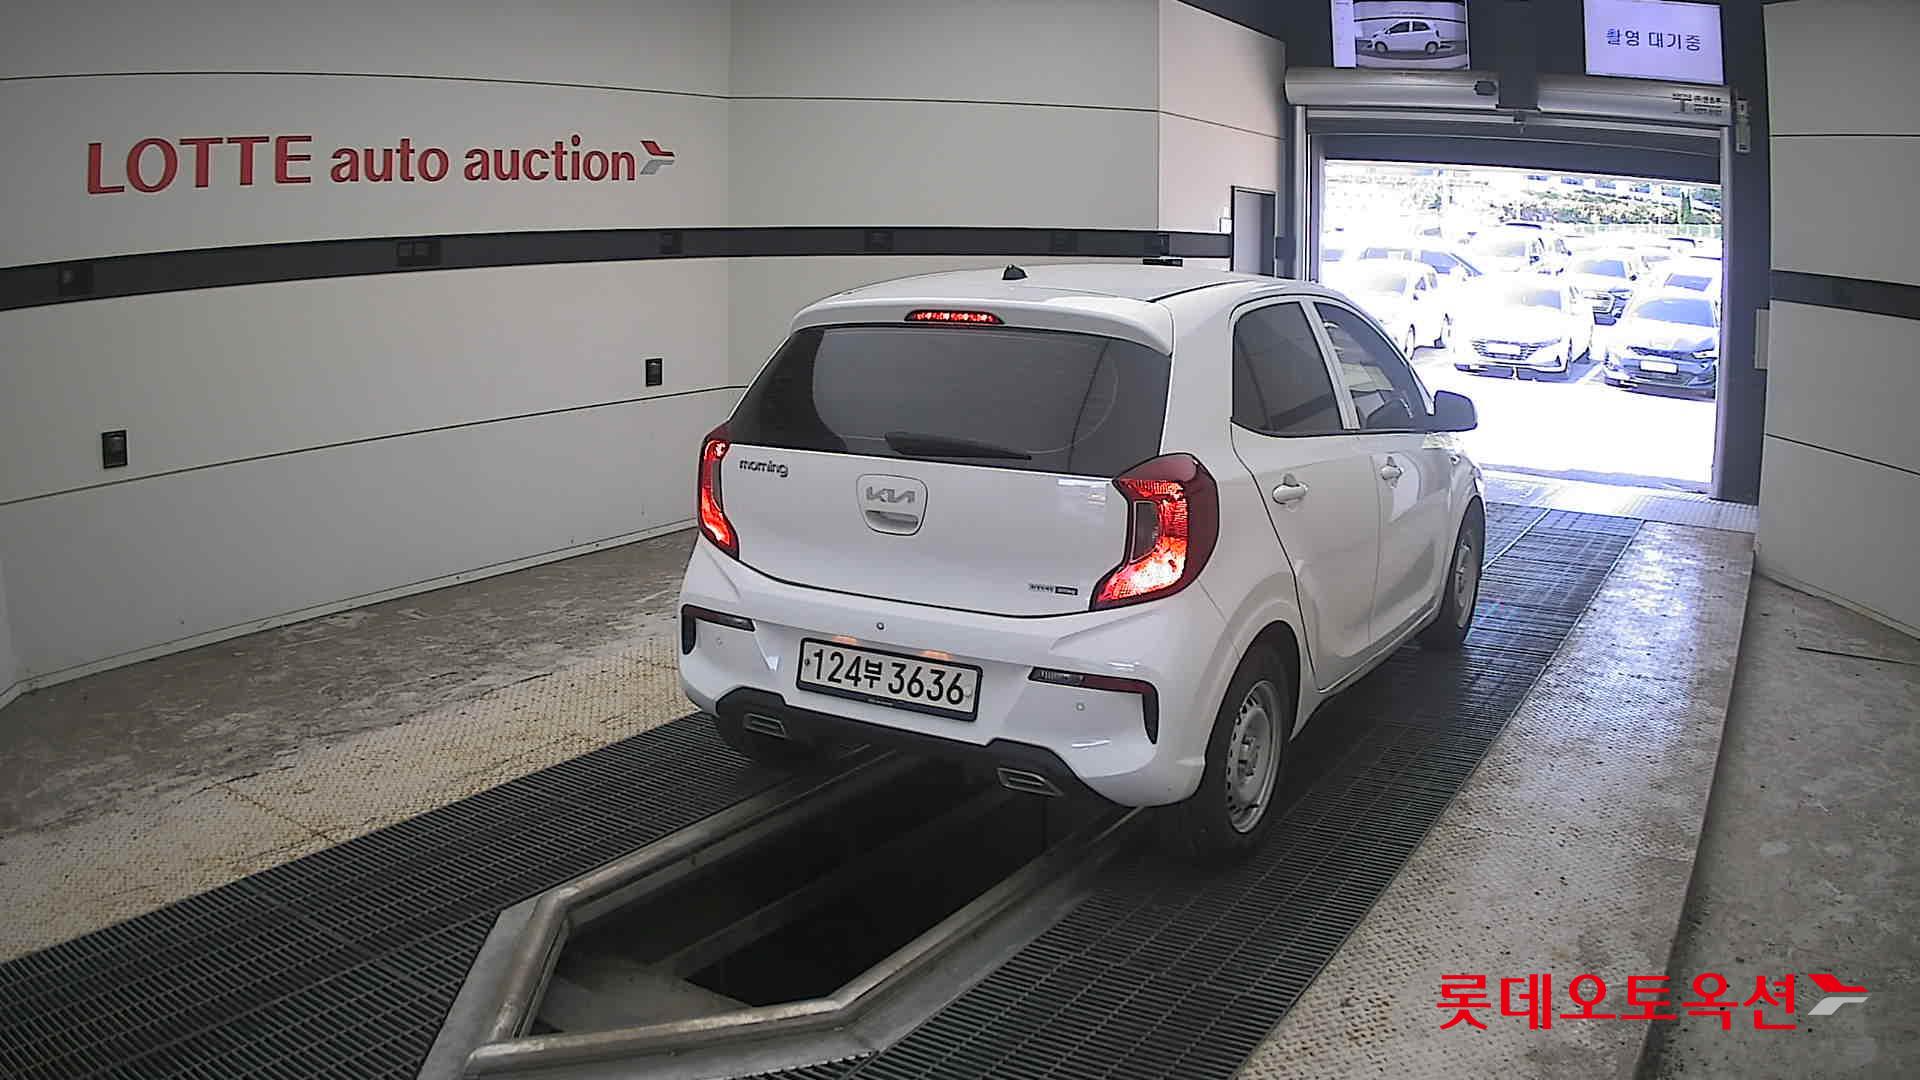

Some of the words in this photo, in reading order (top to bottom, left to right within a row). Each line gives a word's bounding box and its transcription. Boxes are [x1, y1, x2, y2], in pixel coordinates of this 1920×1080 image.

[1648, 31, 1701, 52] 대기중
[87, 135, 313, 195] LOTTE
[330, 138, 450, 183] auto
[463, 134, 636, 183] auction
[739, 458, 789, 478] morning
[813, 649, 883, 689] 124부
[888, 662, 964, 705] 3636
